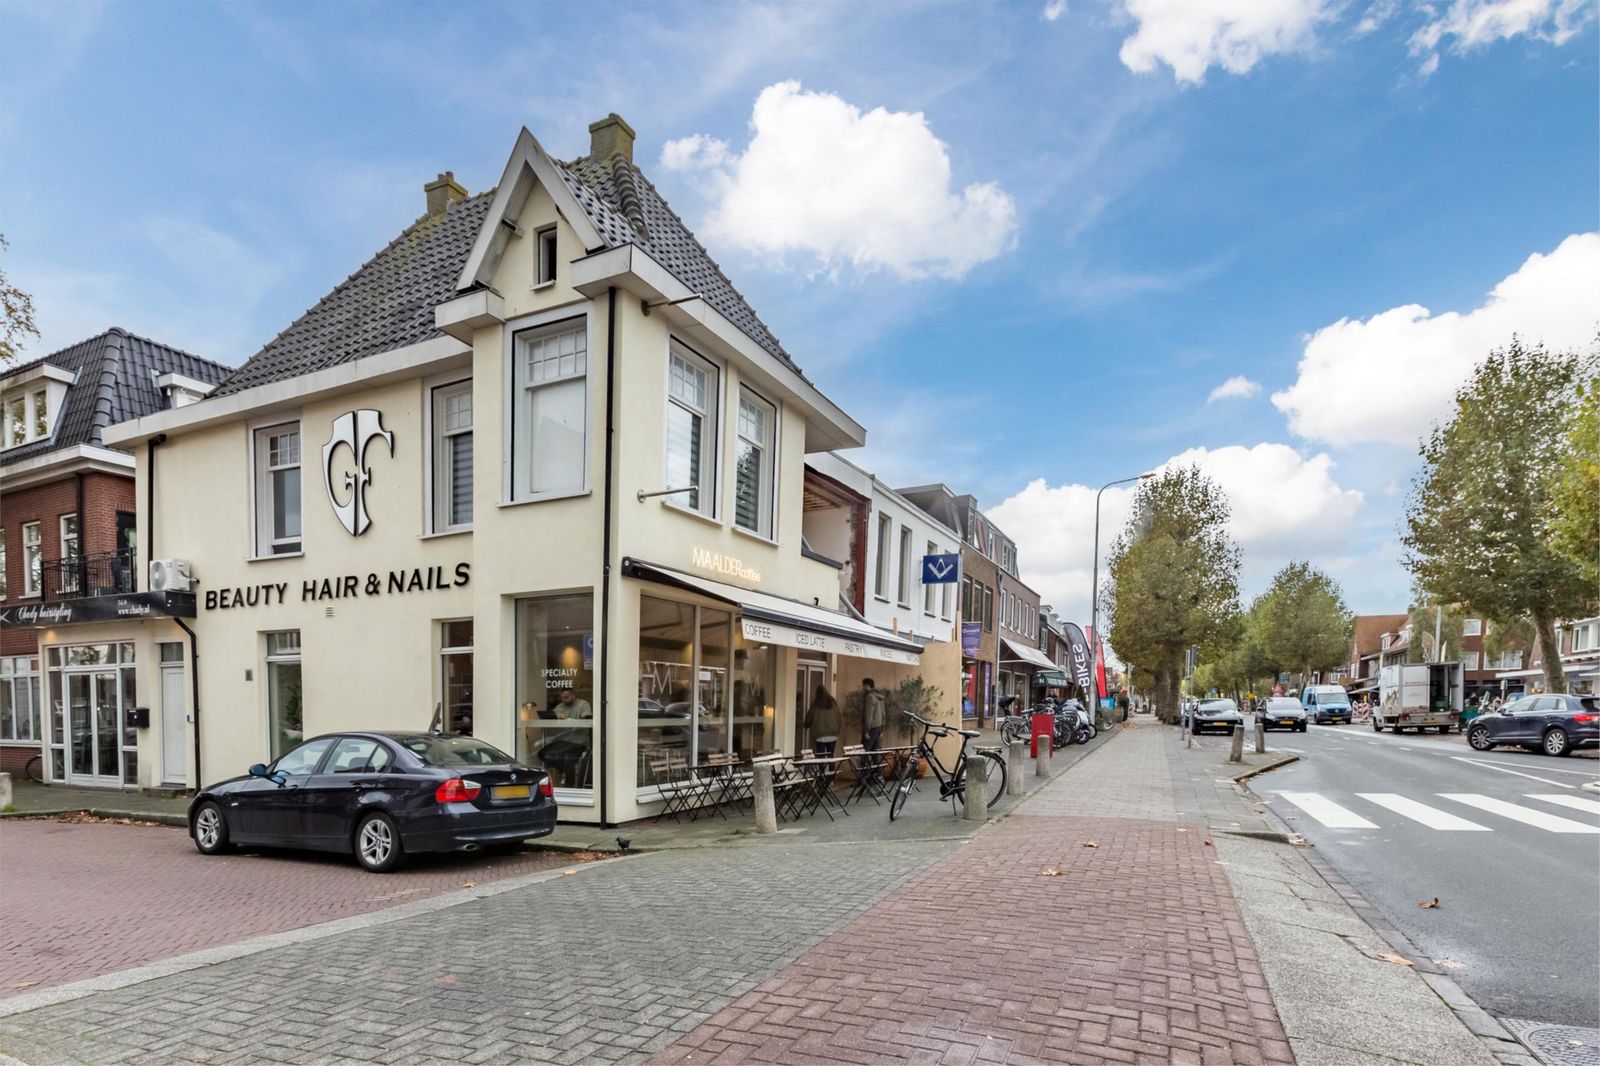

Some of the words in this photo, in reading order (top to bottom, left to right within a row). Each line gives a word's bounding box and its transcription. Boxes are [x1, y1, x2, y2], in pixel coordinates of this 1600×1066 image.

[692, 547, 742, 577] MAALDER
[205, 583, 288, 610] BEAUTY
[302, 575, 358, 601] HAIR
[365, 573, 381, 596] &
[388, 562, 470, 594] NAILS
[745, 623, 771, 639] COFFEE
[795, 632, 809, 645] ICED
[810, 636, 825, 648] LATTE
[541, 667, 578, 678] SPECIALTY
[545, 679, 574, 689] COFFEE
